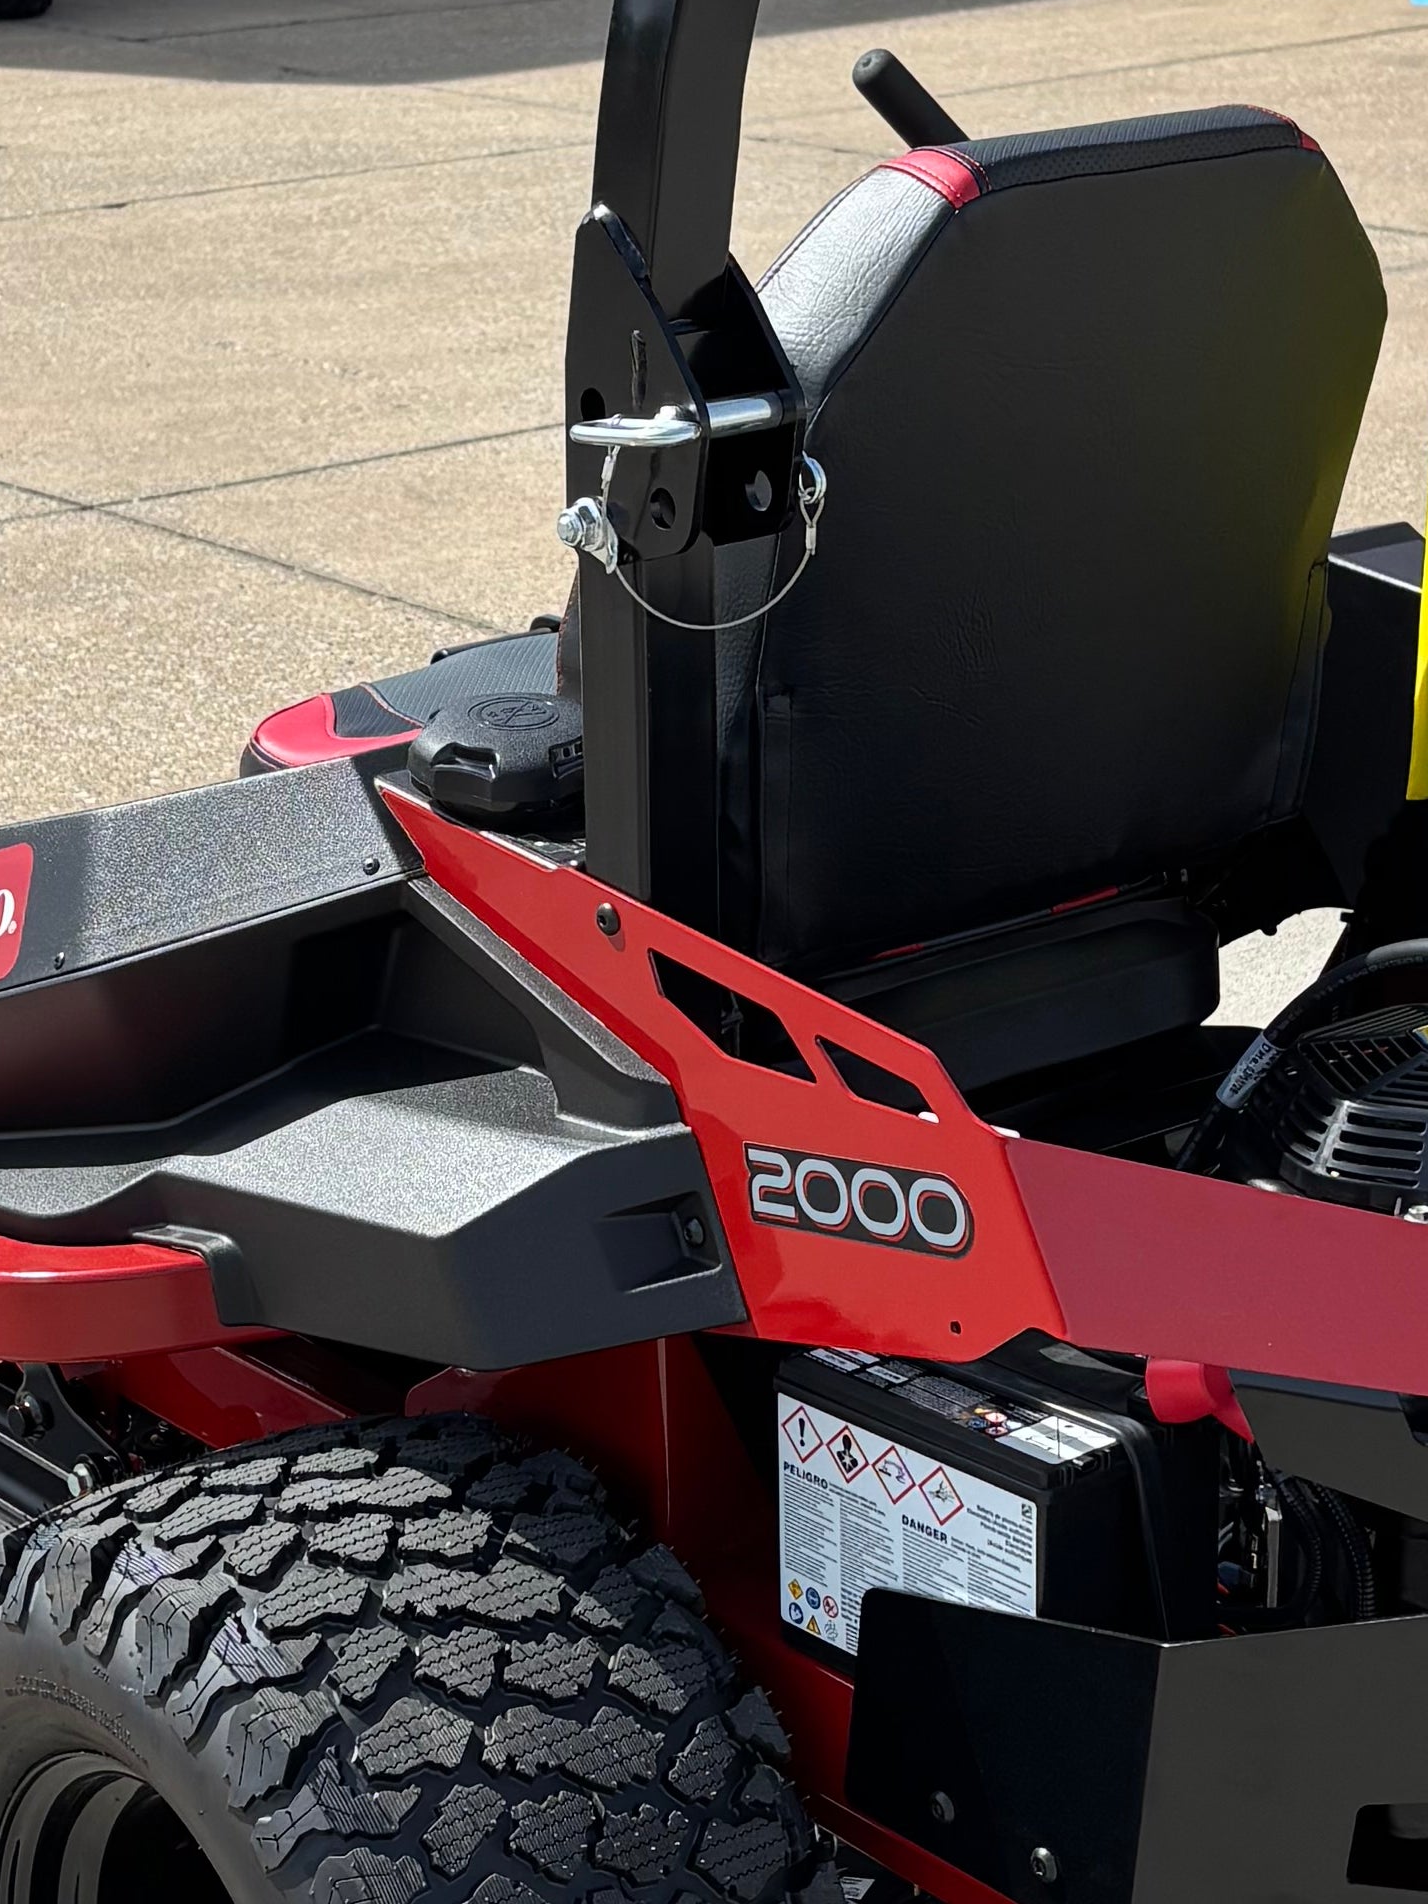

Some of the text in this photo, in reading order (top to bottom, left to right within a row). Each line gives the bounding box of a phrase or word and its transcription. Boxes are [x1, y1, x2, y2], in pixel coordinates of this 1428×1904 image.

[746, 1147, 970, 1254] 2000
[783, 1461, 829, 1490] PELIGRO
[901, 1514, 949, 1545] DANGER
